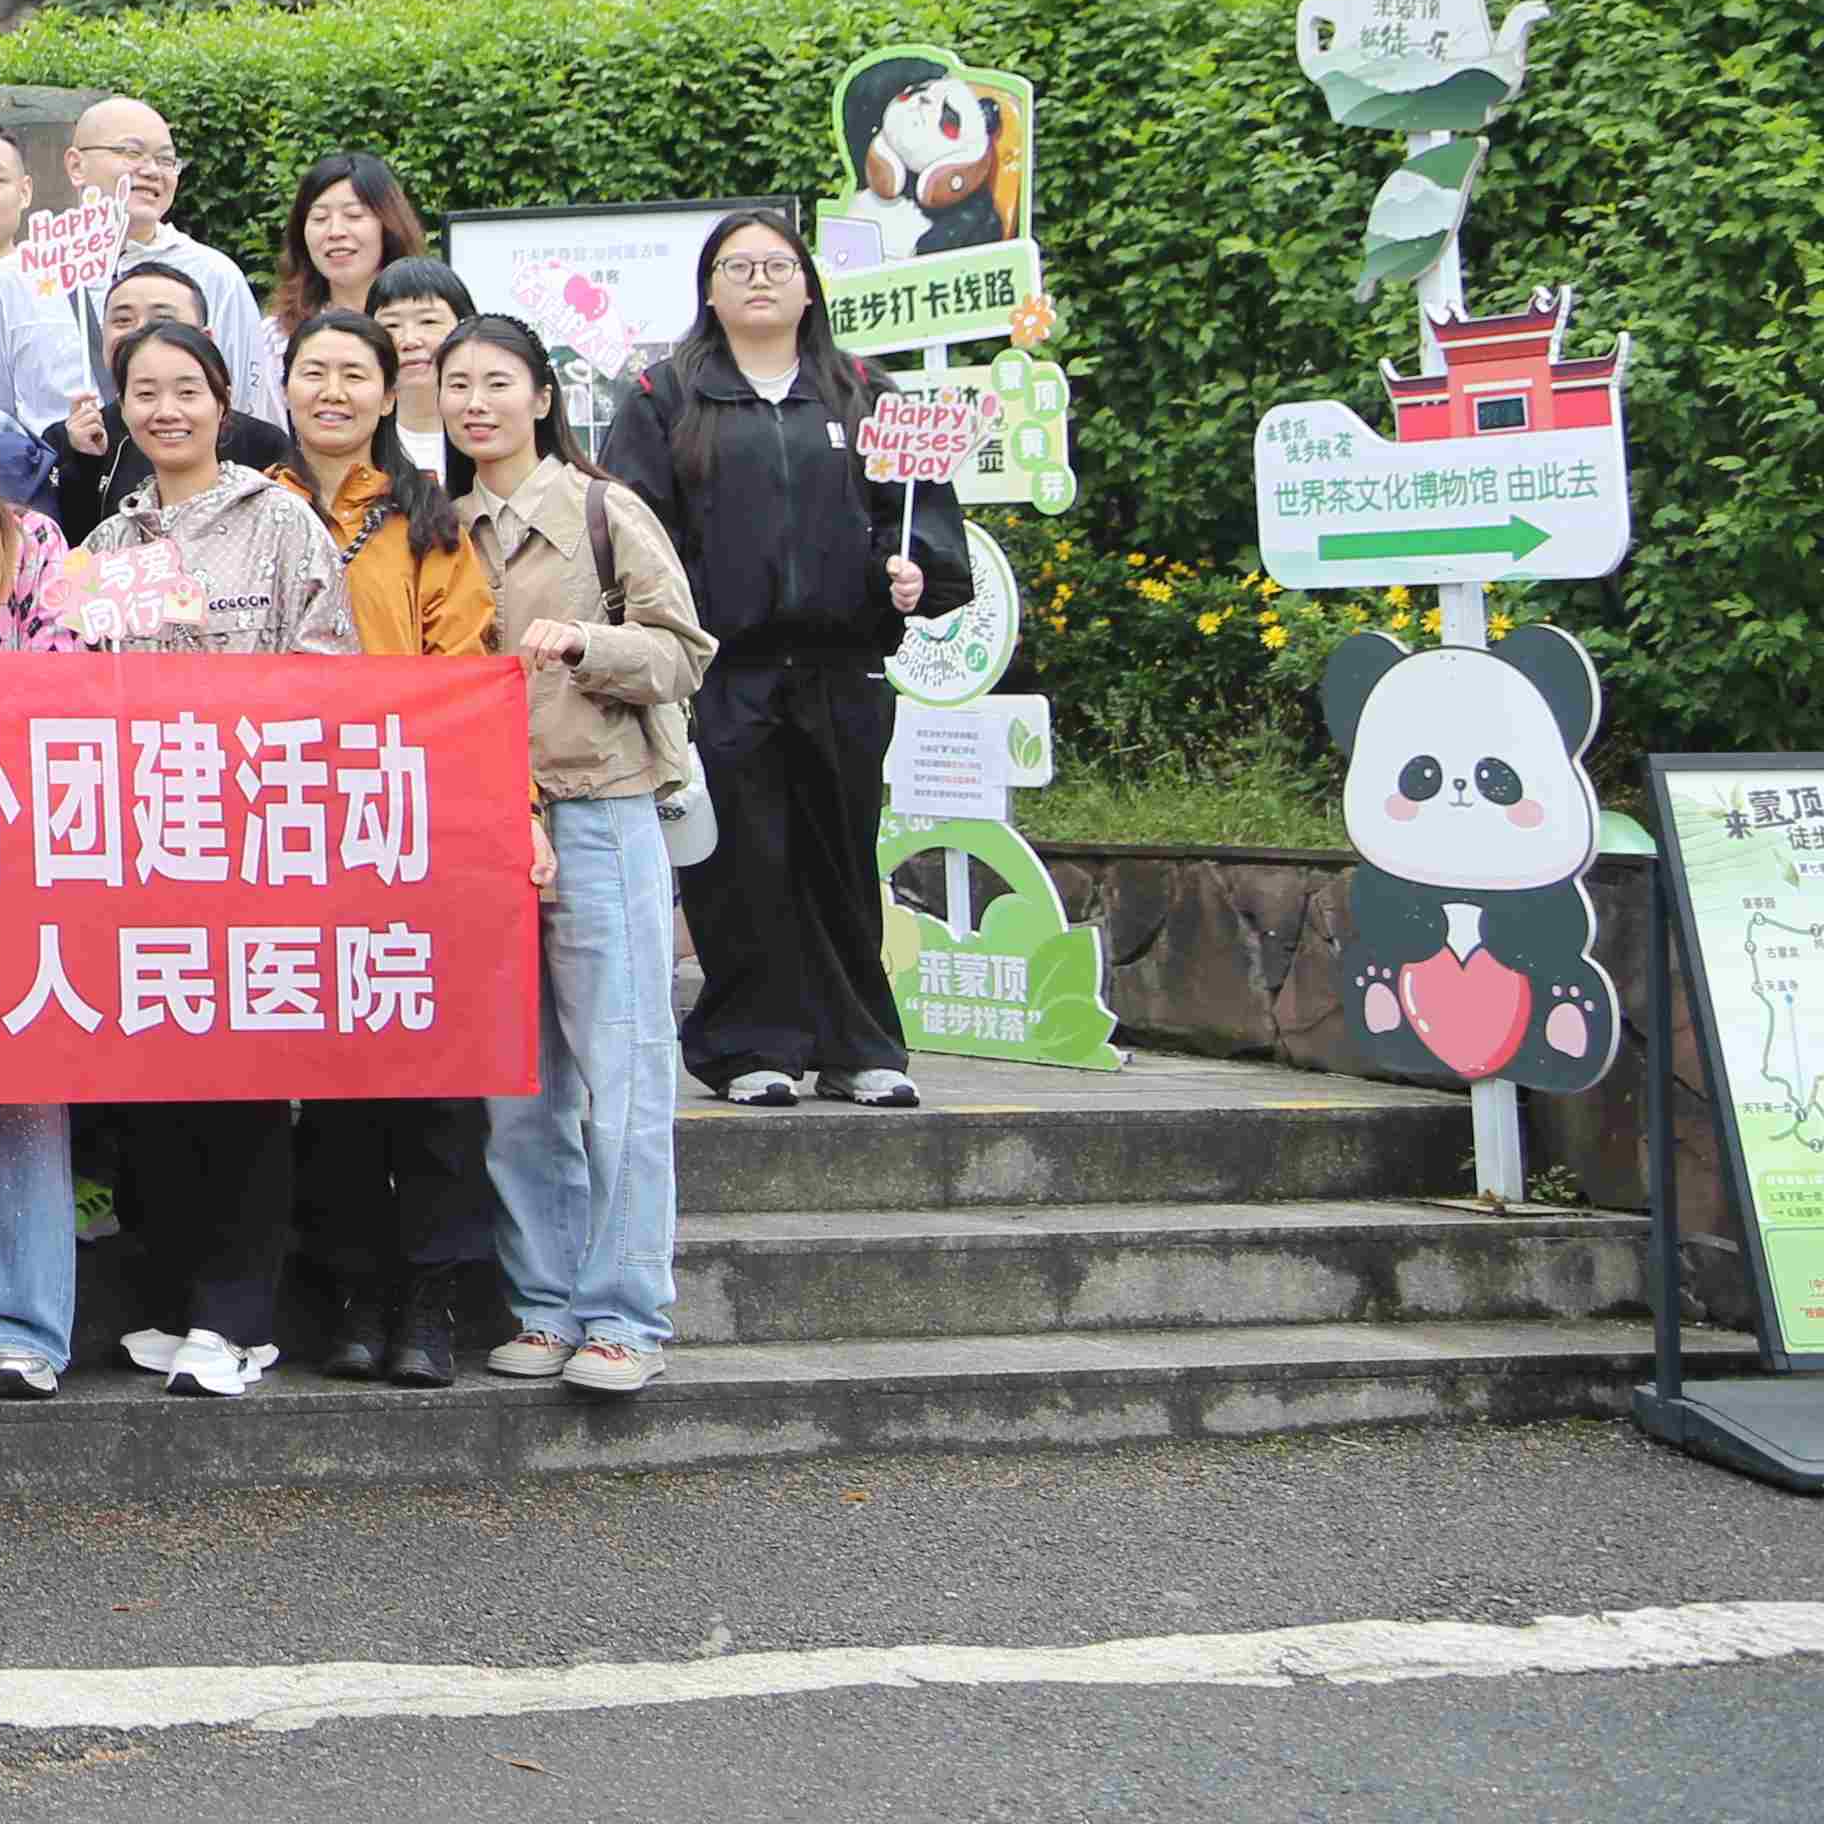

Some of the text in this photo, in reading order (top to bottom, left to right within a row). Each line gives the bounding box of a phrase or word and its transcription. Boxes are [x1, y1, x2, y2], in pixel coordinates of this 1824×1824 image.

[33, 200, 109, 243] Happy
[21, 228, 114, 273] Nurses
[60, 254, 107, 288] Day
[831, 267, 1016, 335] 徒步打卡线路
[878, 398, 969, 429] Happy
[860, 426, 968, 453] Nurses
[898, 453, 952, 478] Day
[1274, 459, 1600, 517] 世界茶文化博物馆 由此去
[102, 542, 174, 587] 与爱
[80, 591, 164, 645] 同行
[917, 950, 1029, 1003] 来蒙顶
